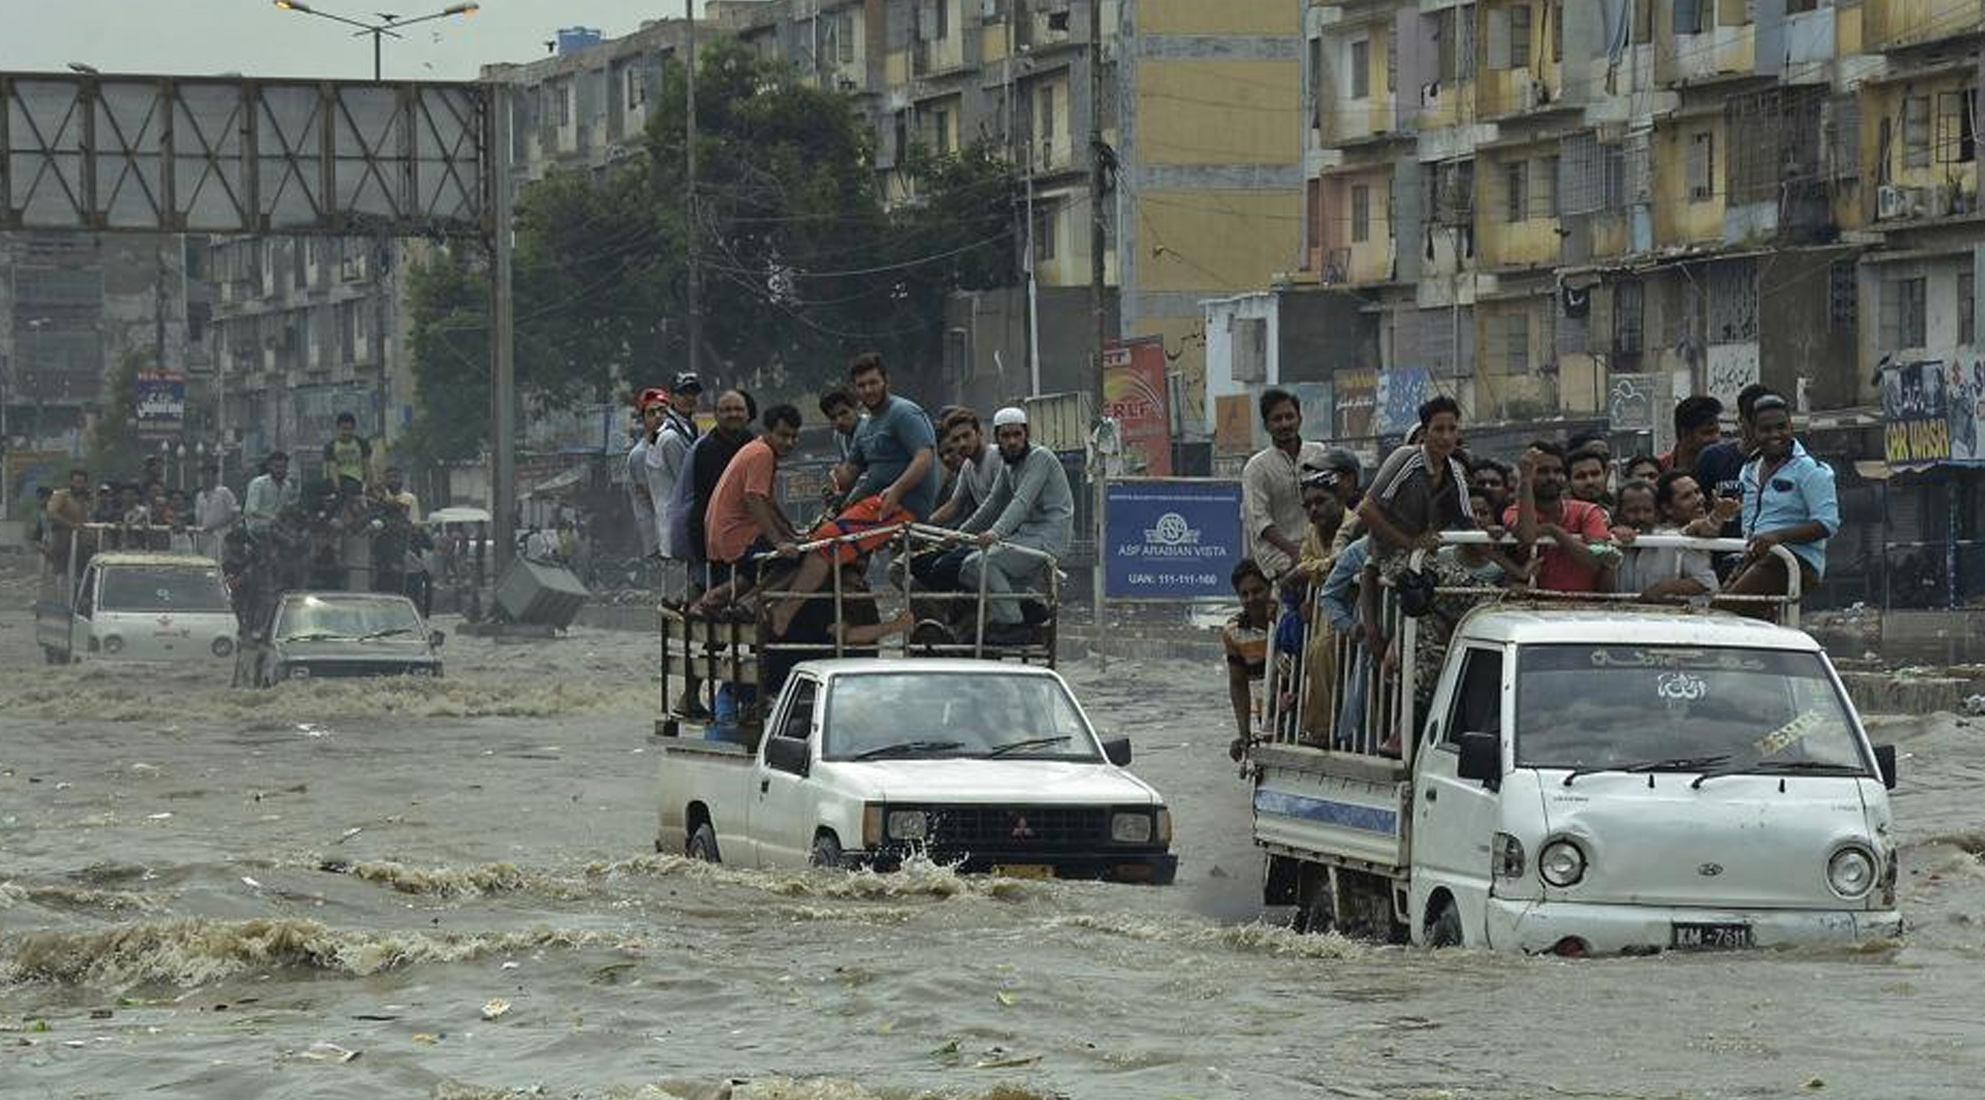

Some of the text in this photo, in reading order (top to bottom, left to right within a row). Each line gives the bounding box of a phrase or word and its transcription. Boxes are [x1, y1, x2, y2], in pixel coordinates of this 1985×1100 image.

[1884, 418, 1950, 463] CAR WASH
[1141, 544, 1192, 557] ARABIAN
[1192, 545, 1227, 558] VISTA
[1128, 573, 1155, 584] UAN:
